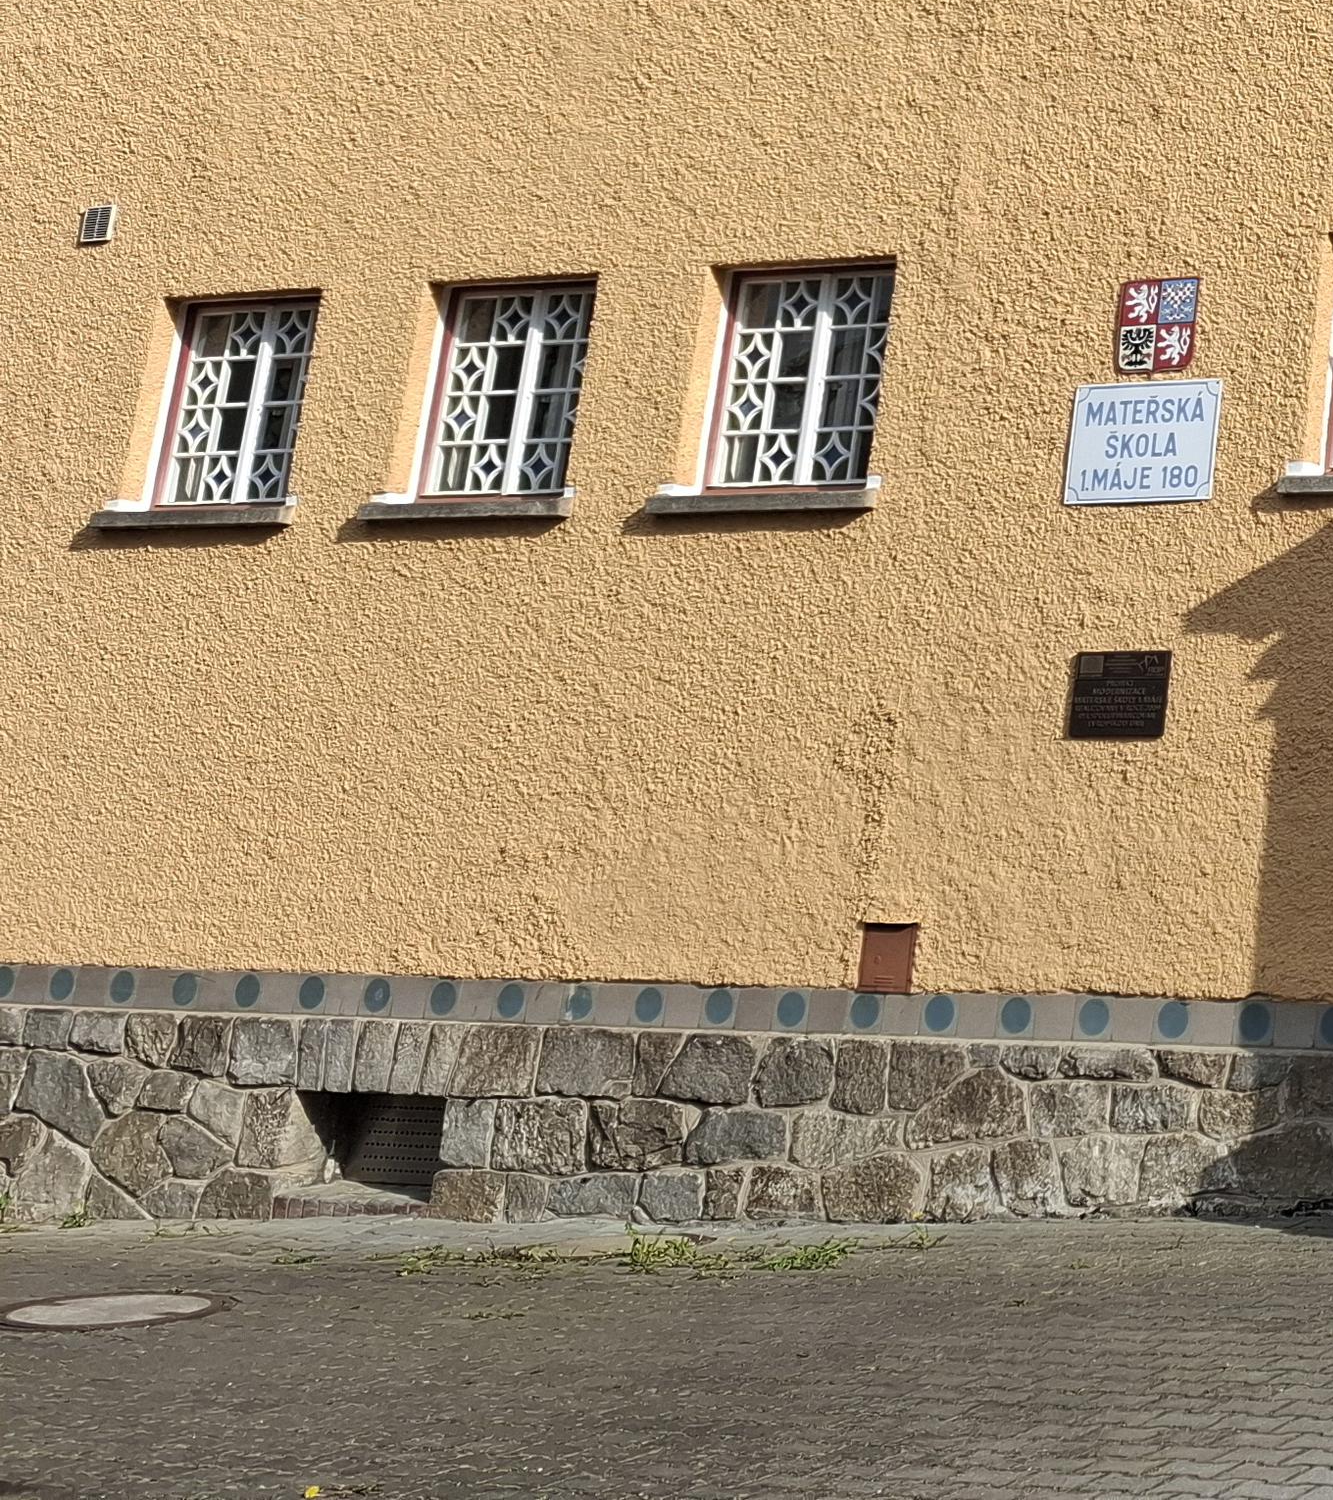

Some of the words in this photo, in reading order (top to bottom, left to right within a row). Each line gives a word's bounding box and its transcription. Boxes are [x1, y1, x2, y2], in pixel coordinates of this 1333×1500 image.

[1085, 392, 1205, 427] MATEŘSKÁ
[1105, 431, 1177, 459] ŠKOLA
[1161, 465, 1198, 489] 180
